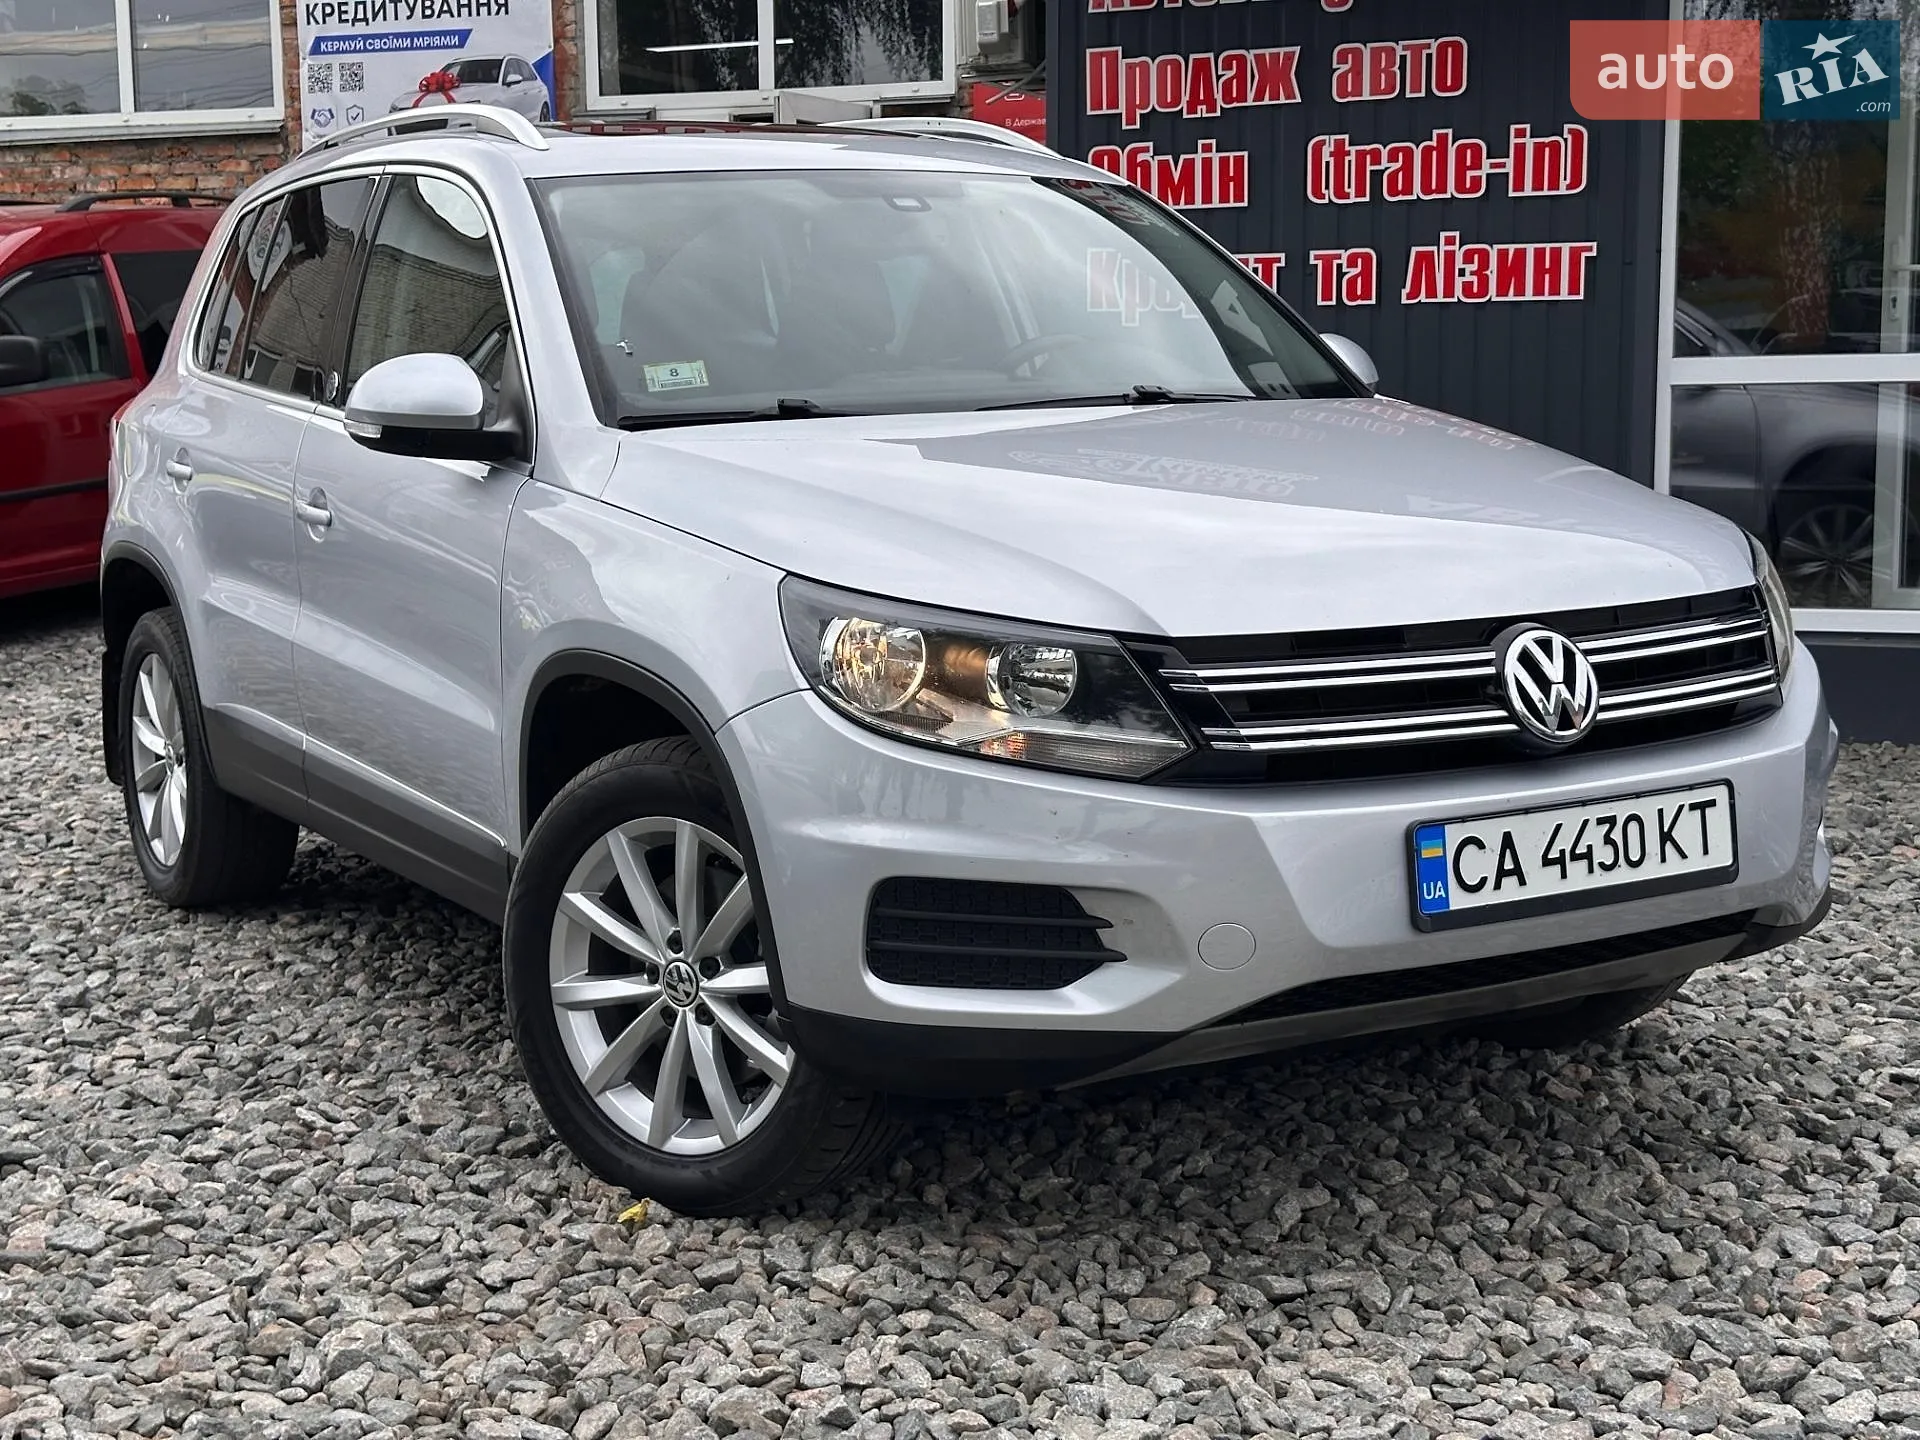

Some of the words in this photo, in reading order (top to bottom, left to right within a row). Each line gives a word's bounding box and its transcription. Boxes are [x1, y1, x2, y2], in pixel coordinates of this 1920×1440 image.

[305, 0, 510, 27] КРЕДИТУВАННЯ
[320, 37, 364, 52] КЕРМУЙ
[366, 35, 411, 50] СВОЇМИ
[413, 34, 459, 48] МРІЯМИ
[1086, 46, 1301, 129] Продаж
[1332, 36, 1468, 102] авто
[1307, 124, 1588, 204] (trade-in)
[1310, 248, 1376, 306] та
[1401, 231, 1597, 305] лізинг
[1423, 881, 1446, 900] UA
[1452, 830, 1527, 893] CA
[1541, 812, 1647, 880] 4430
[1656, 798, 1717, 863] KT
